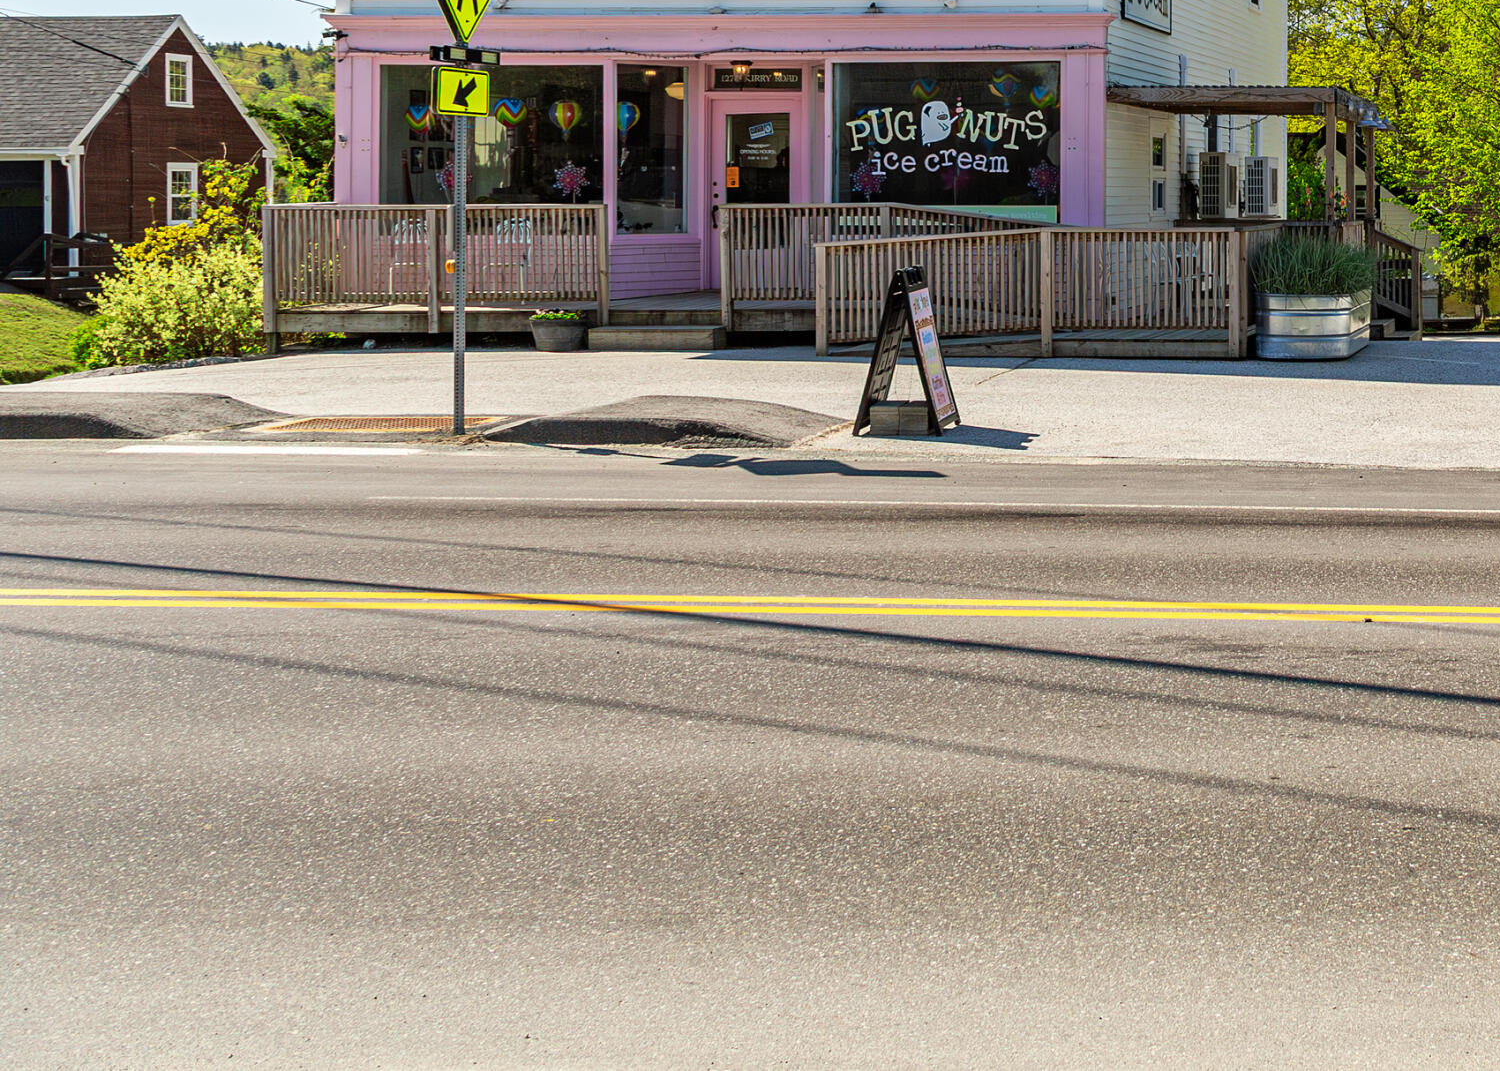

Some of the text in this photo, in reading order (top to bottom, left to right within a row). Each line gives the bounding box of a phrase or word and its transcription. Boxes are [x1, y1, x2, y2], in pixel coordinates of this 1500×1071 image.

[774, 74, 798, 82] ROAD
[846, 107, 1048, 151] PUG NUTS
[871, 148, 1010, 176] ice cream
